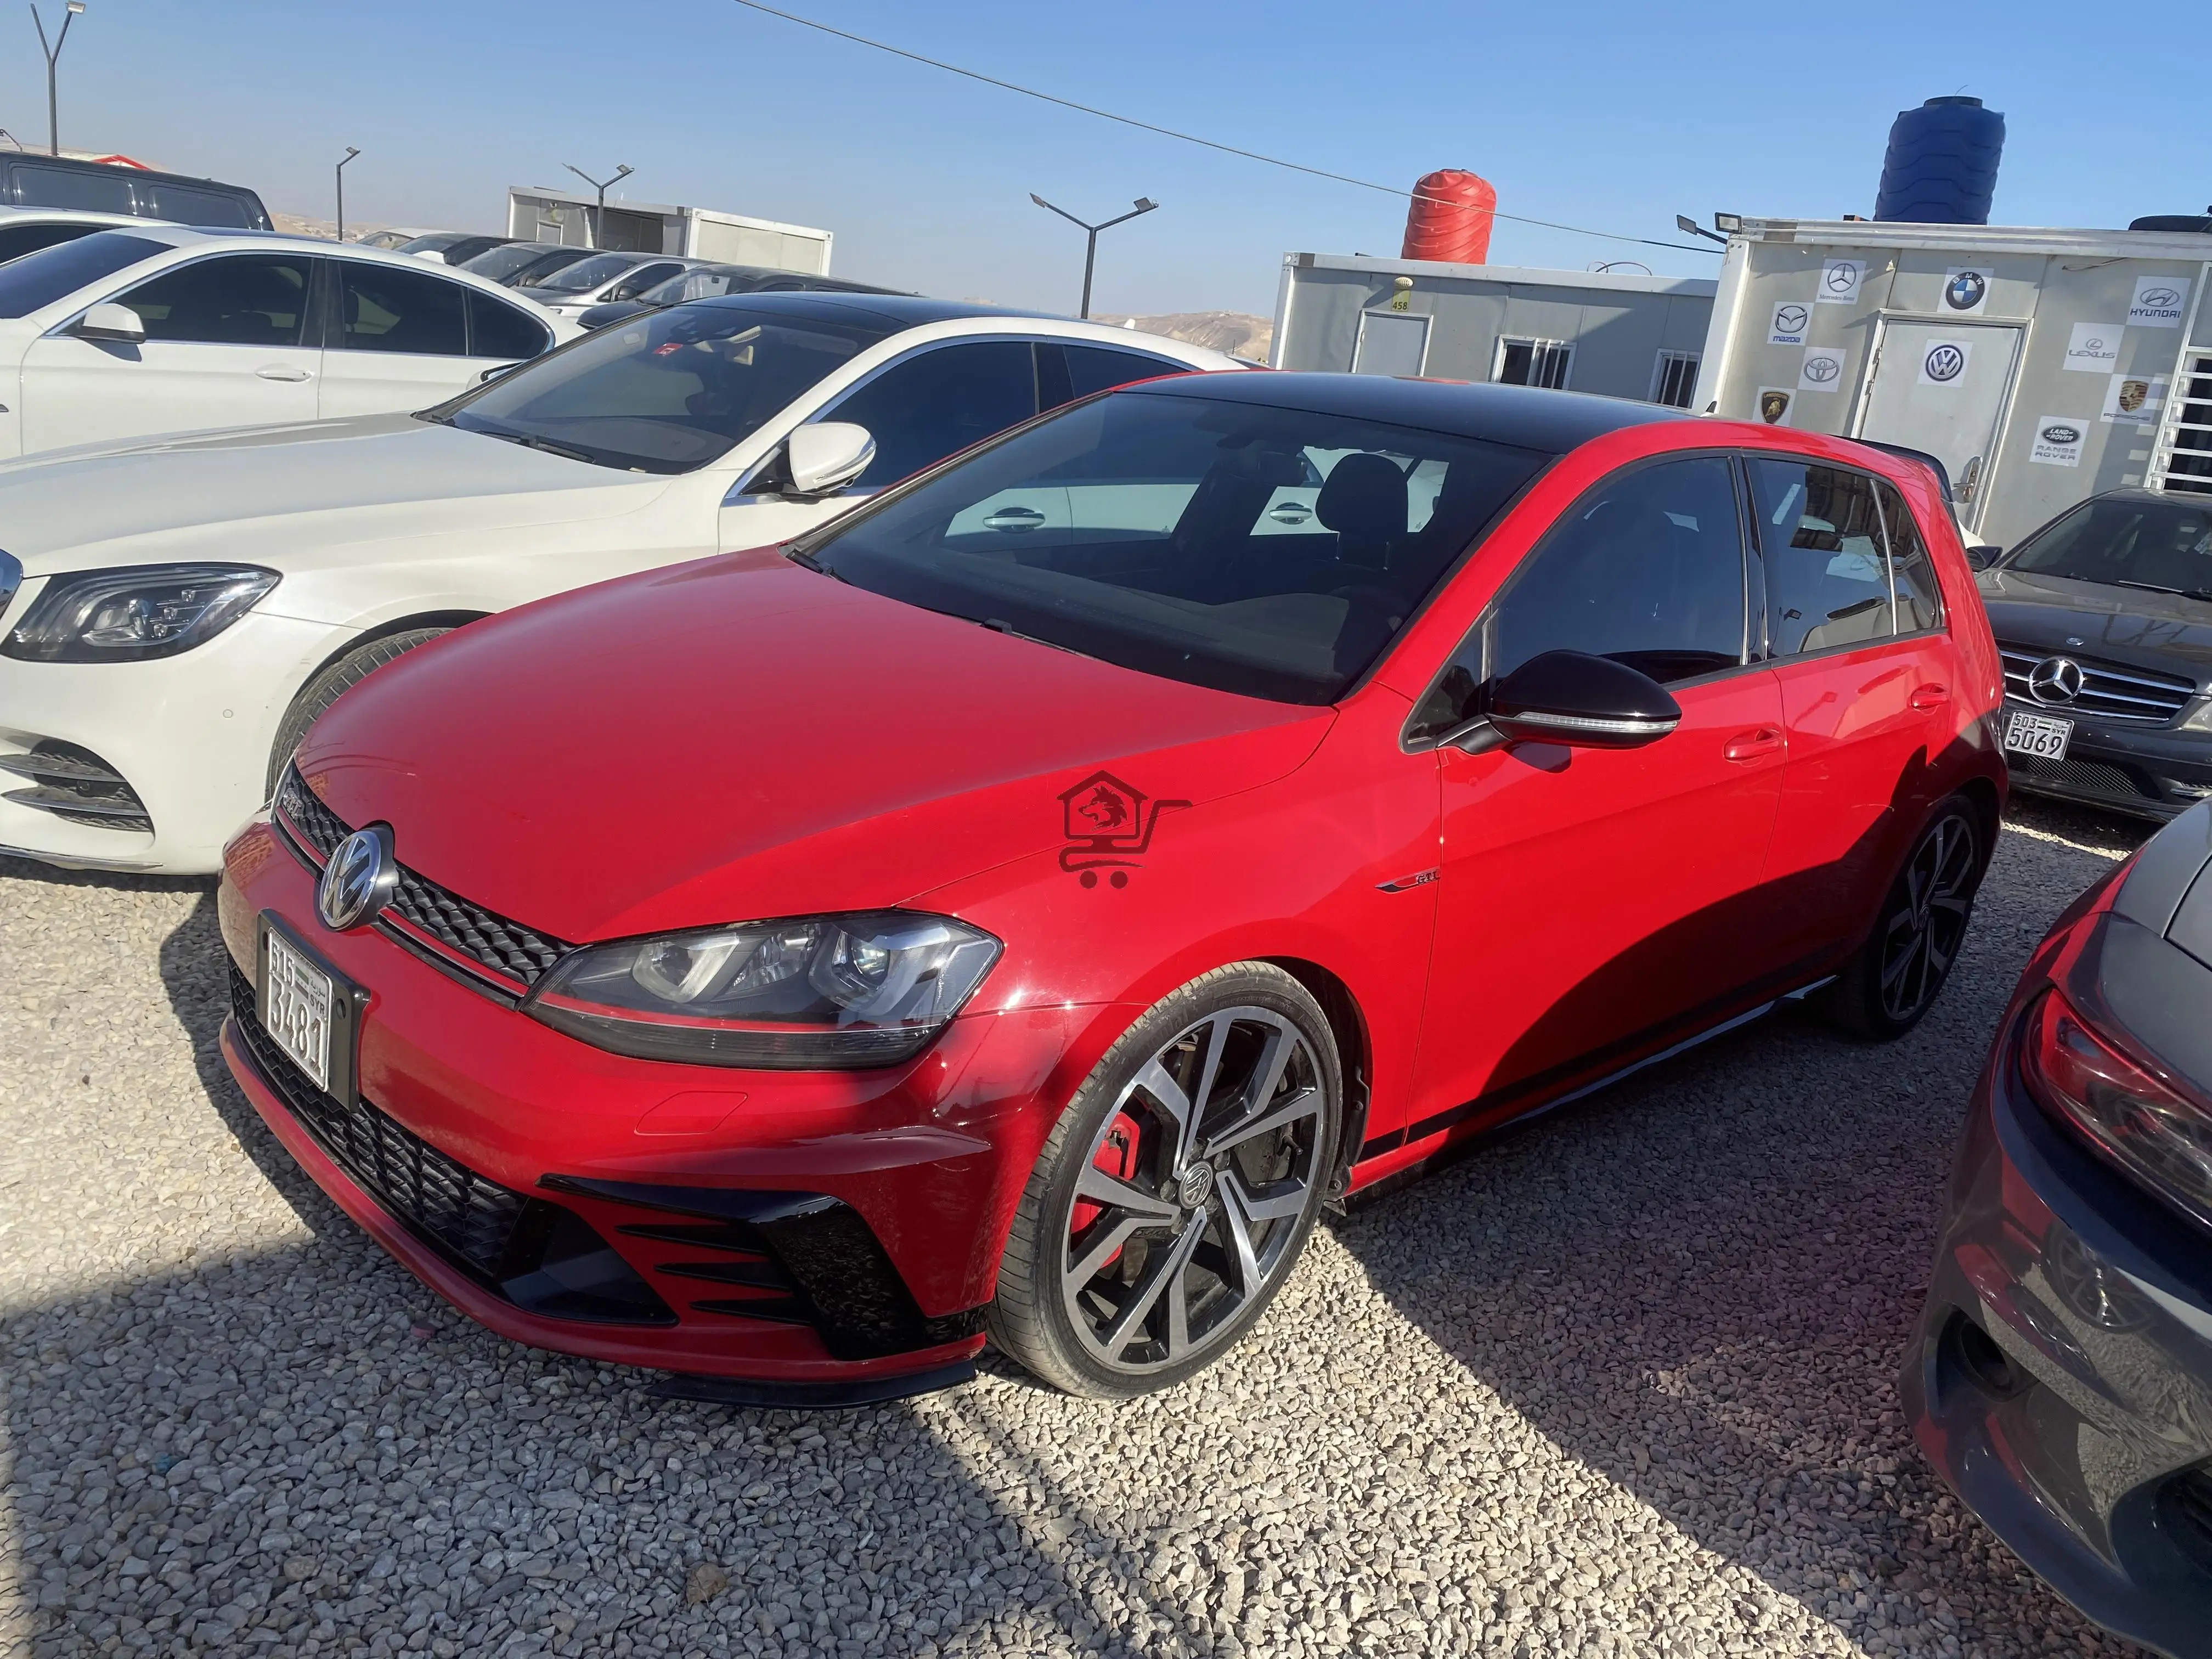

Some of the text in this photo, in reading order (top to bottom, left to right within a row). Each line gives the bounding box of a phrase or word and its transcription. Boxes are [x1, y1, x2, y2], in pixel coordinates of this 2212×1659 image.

[1953, 273, 1984, 285] BMW
[1392, 301, 1408, 310] 458
[2130, 308, 2181, 318] HYUNDAI
[2068, 349, 2116, 359] LEXUS
[2103, 413, 2151, 421] PORSCHE
[2036, 445, 2078, 455] RANGE
[2035, 452, 2076, 460] ROVER
[2014, 715, 2039, 729] 503
[2008, 727, 2064, 755] 5069
[309, 994, 325, 1015] SYR
[272, 972, 326, 1077] 3481
